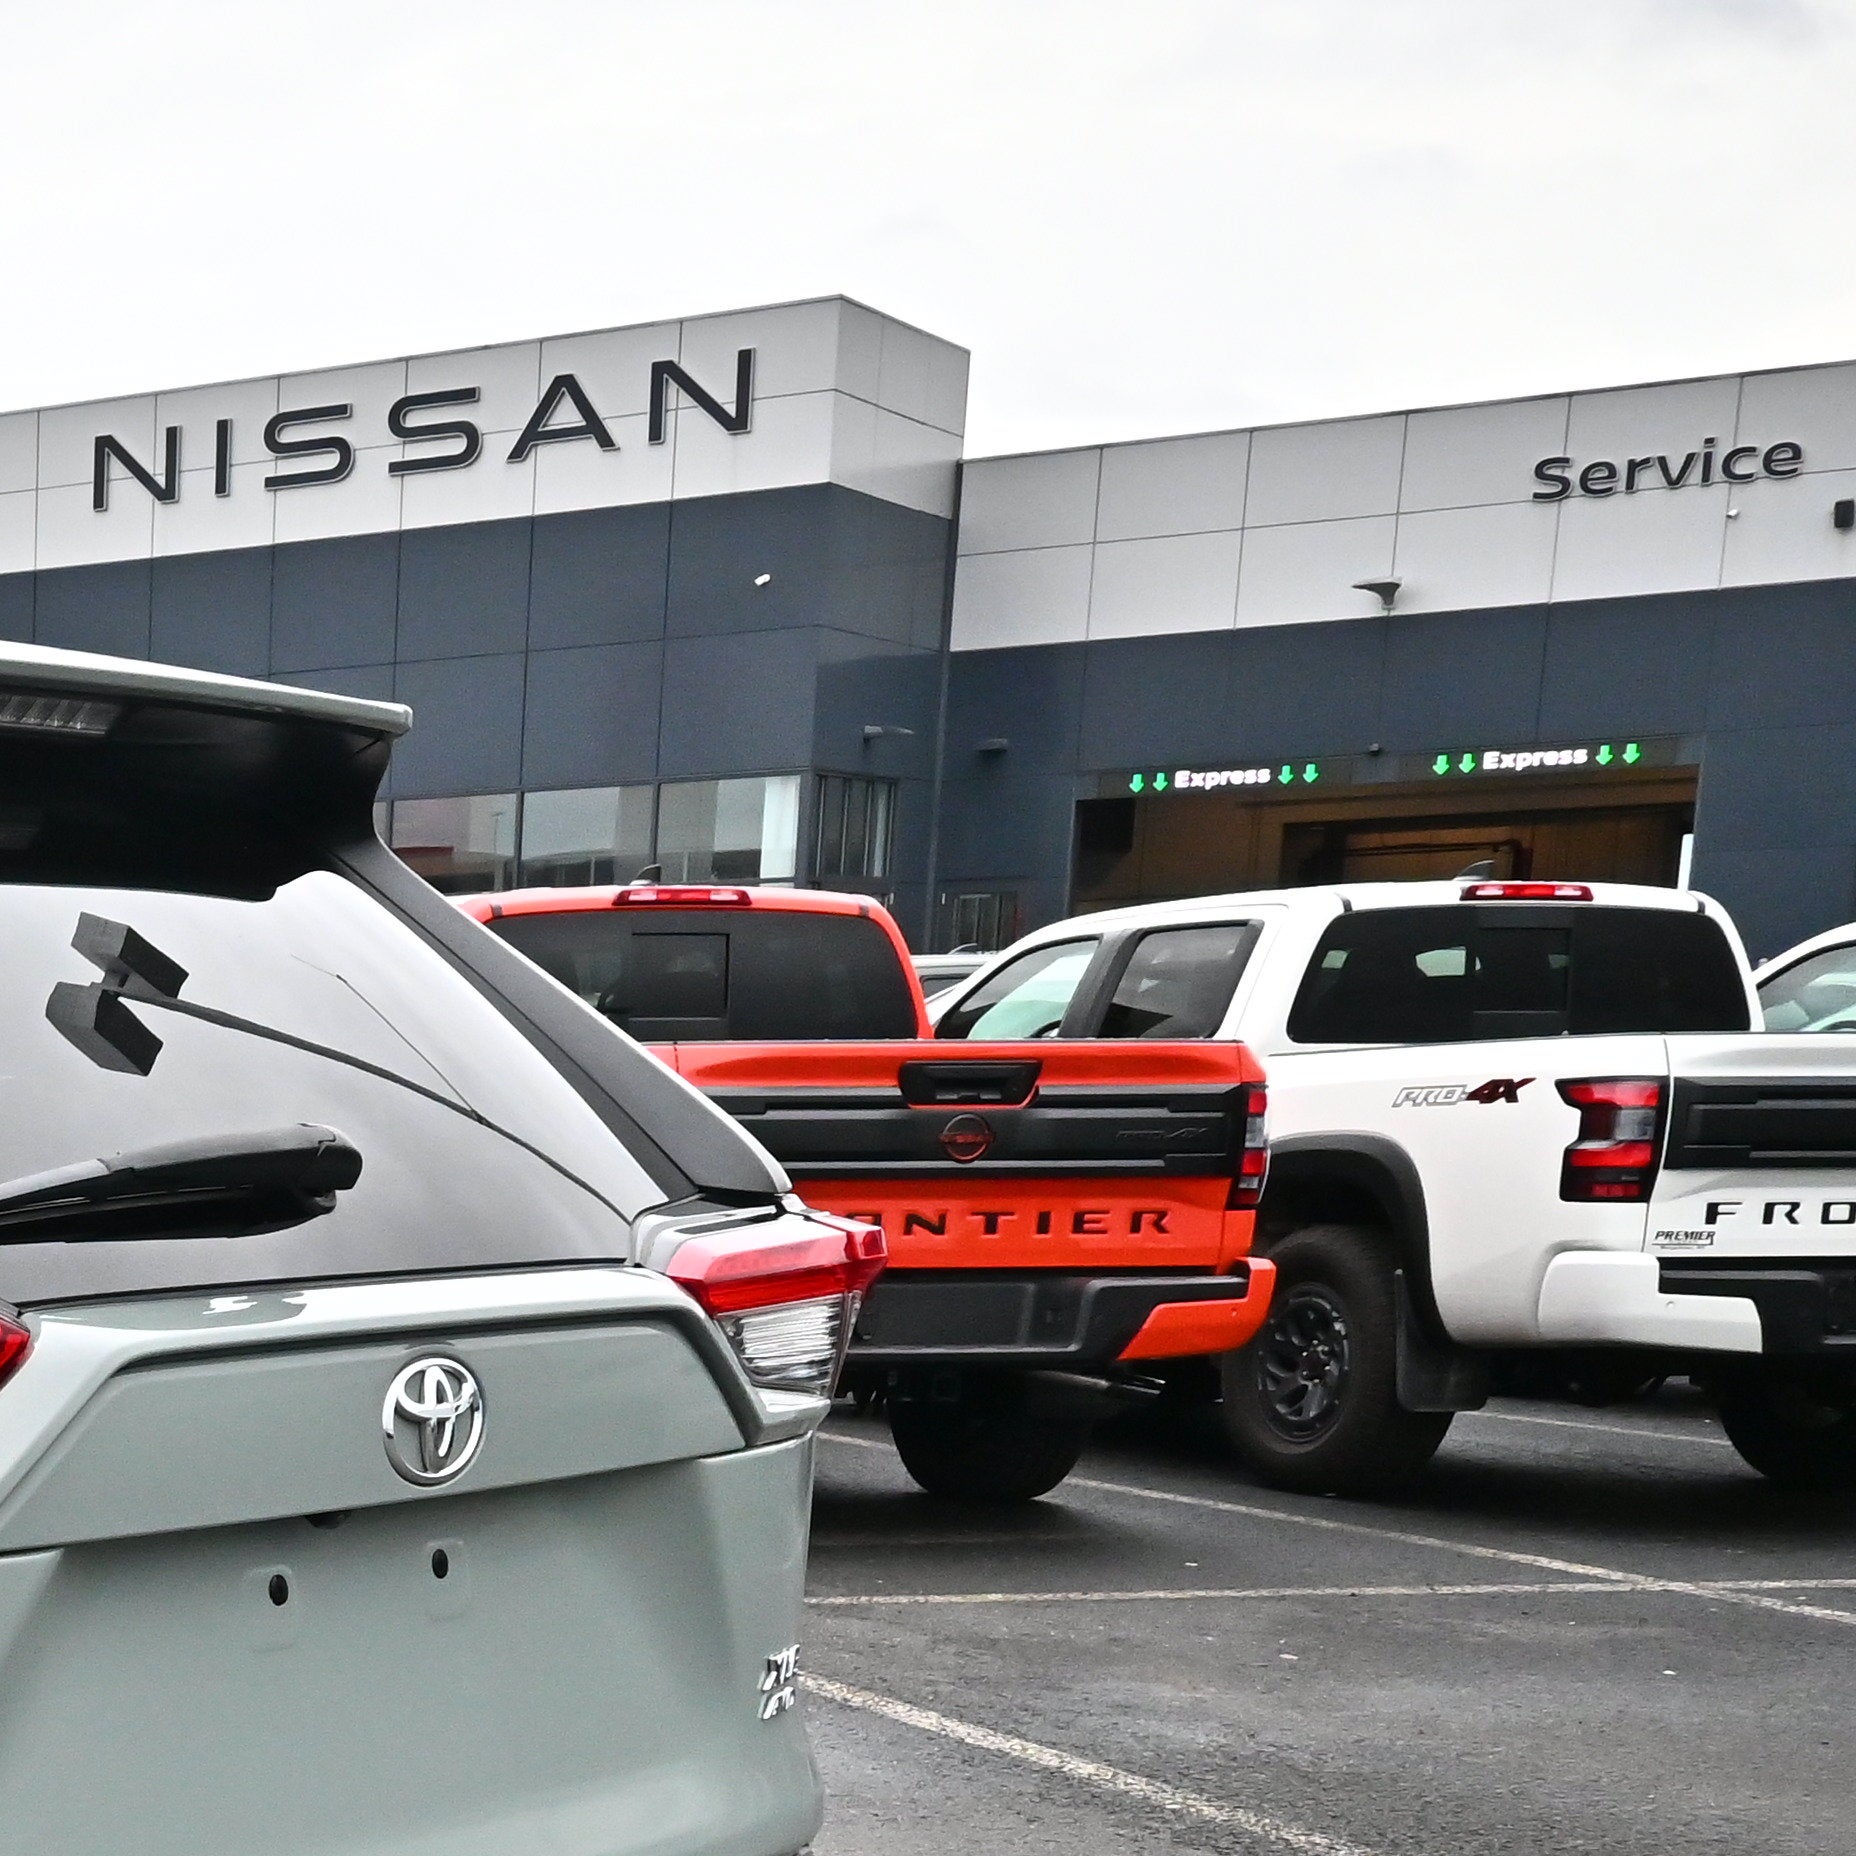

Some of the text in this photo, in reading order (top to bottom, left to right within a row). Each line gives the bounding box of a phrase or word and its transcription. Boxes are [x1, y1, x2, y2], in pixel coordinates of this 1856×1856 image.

[92, 347, 756, 512] NISSAN
[1532, 436, 1804, 502] Service
[1482, 748, 1588, 772] Express
[1174, 768, 1271, 791] Express
[1391, 1077, 1537, 1108] PRO-4X
[1705, 1202, 1856, 1225] FRO
[1654, 1230, 1716, 1243] PREMIER
